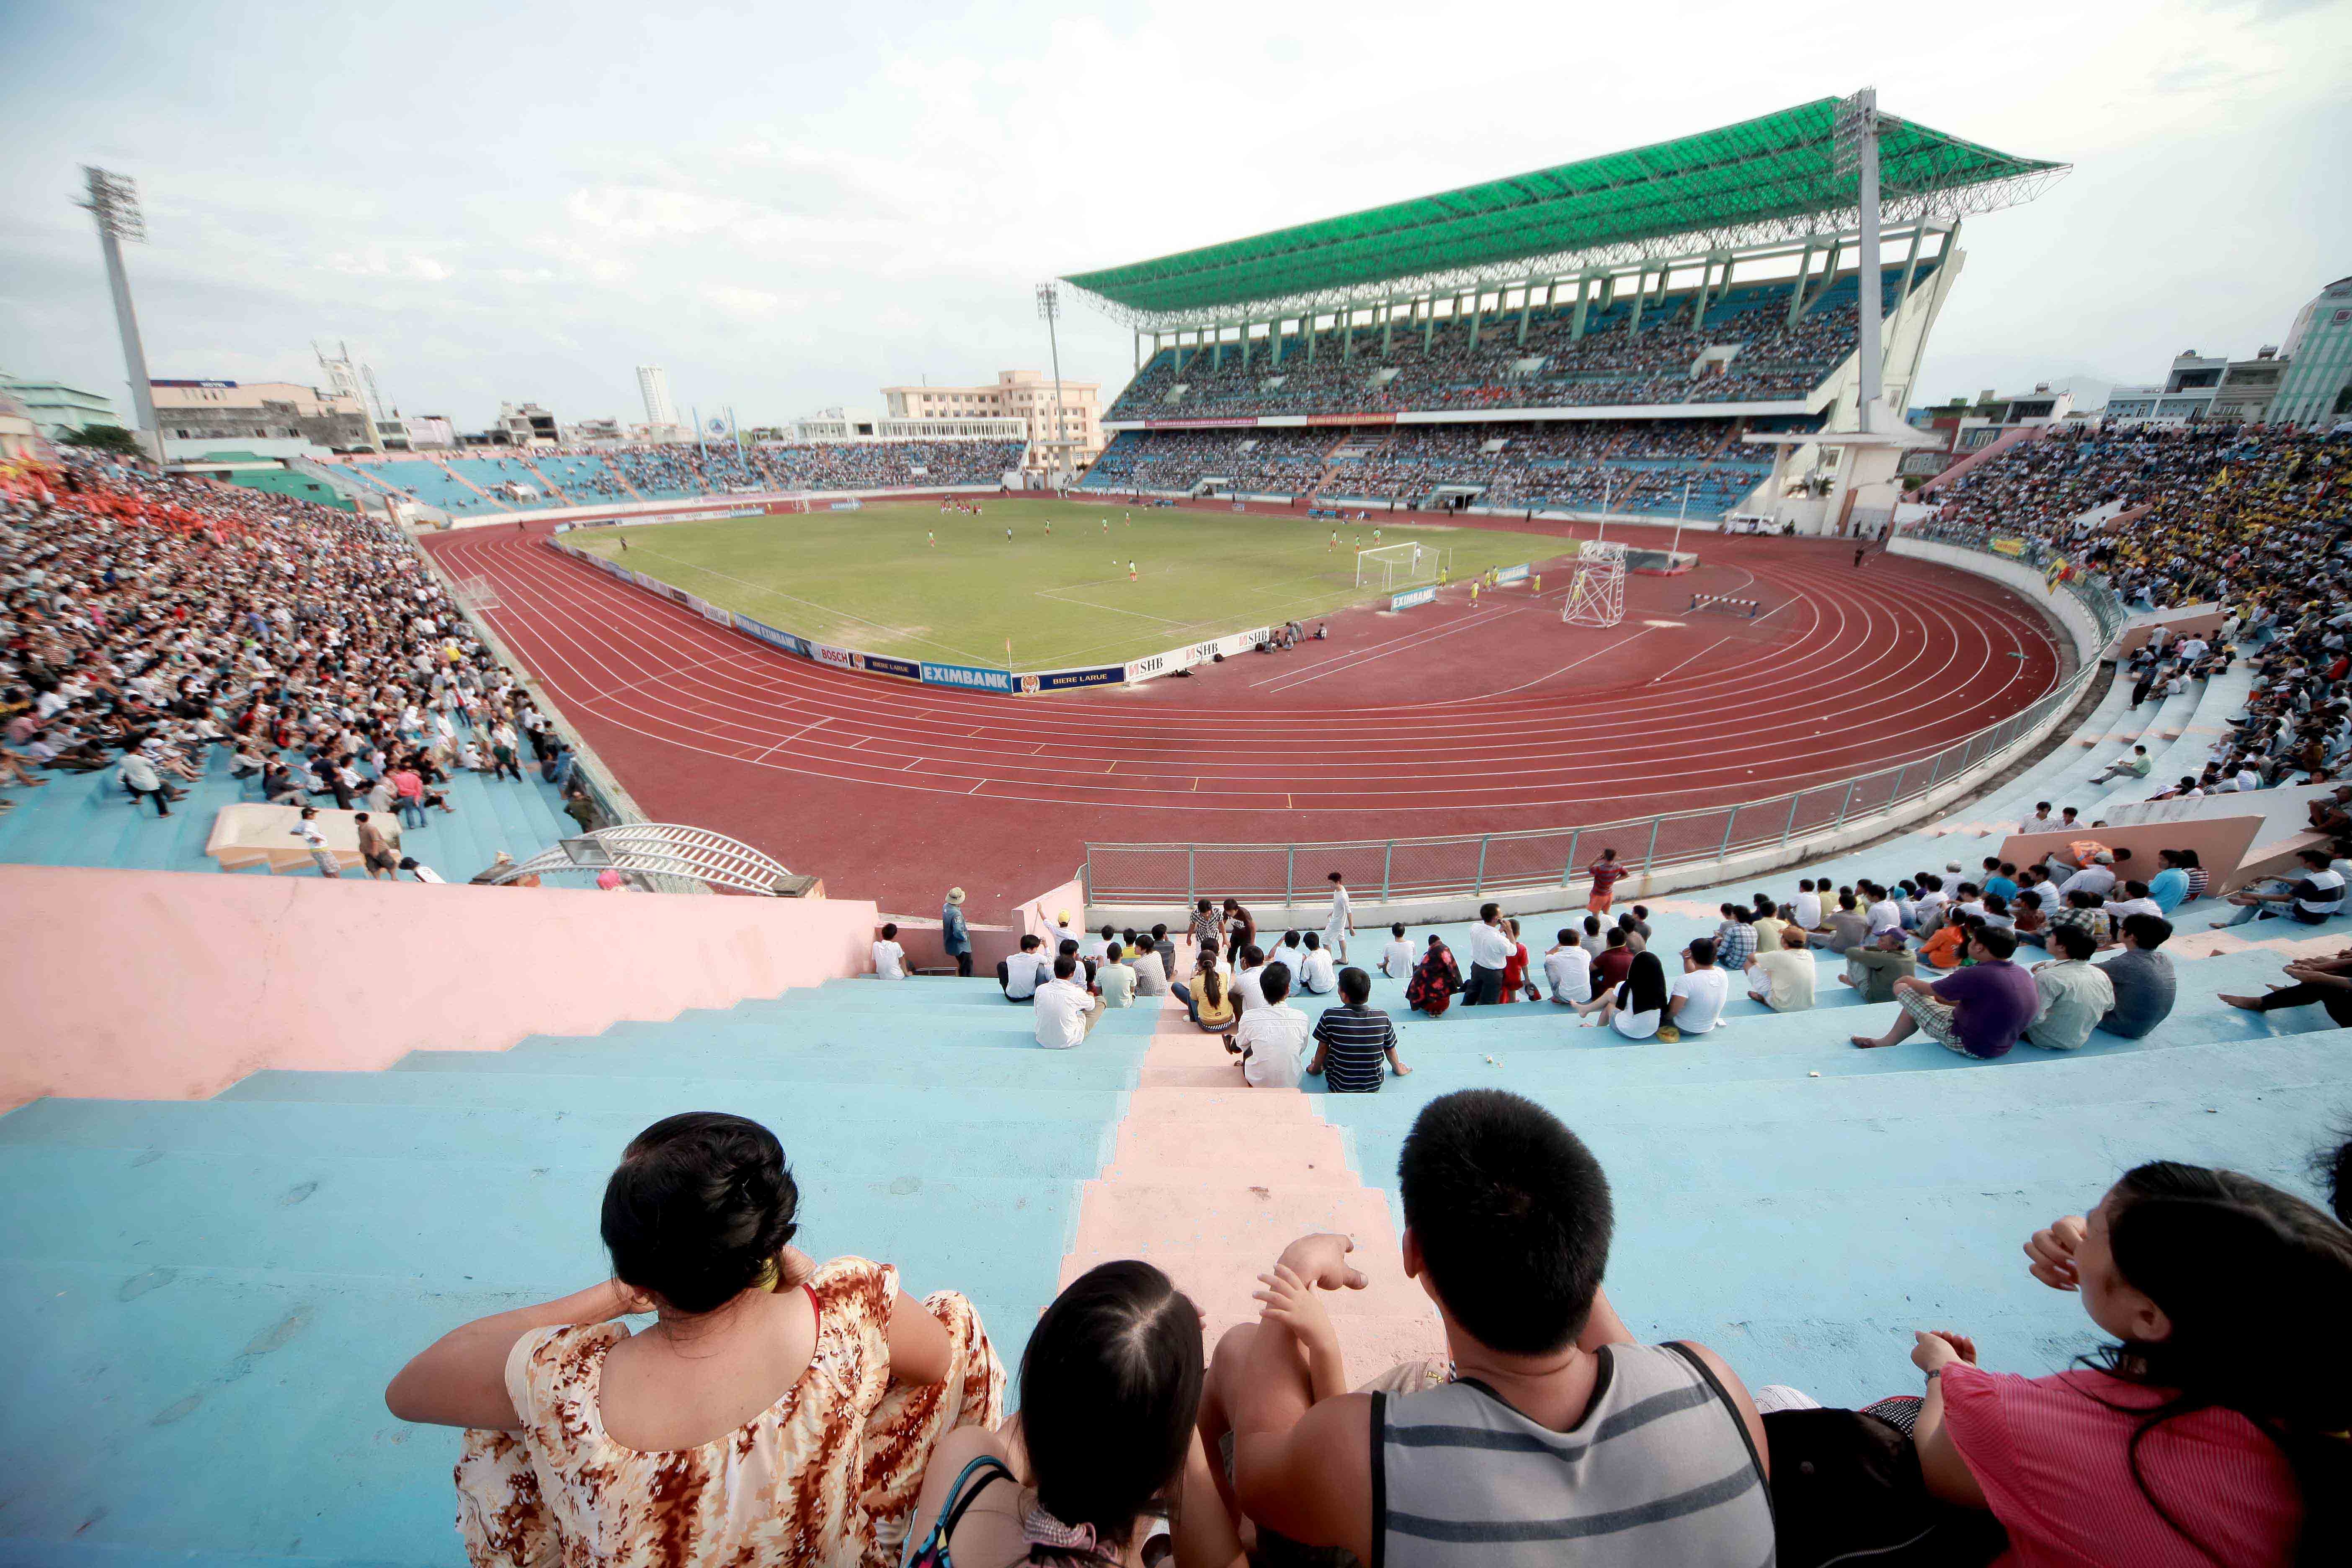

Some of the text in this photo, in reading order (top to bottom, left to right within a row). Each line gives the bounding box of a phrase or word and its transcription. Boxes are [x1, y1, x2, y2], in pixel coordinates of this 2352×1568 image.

[1393, 588, 1433, 607] EXIMBANK
[761, 627, 797, 649] EXIMBANK
[1249, 630, 1267, 644] SHB
[821, 649, 848, 663] BOSCH
[1196, 643, 1218, 657] SHB
[890, 663, 908, 673] LARUE
[1140, 657, 1163, 673] SHB
[923, 666, 1008, 689] EXIMBANK
